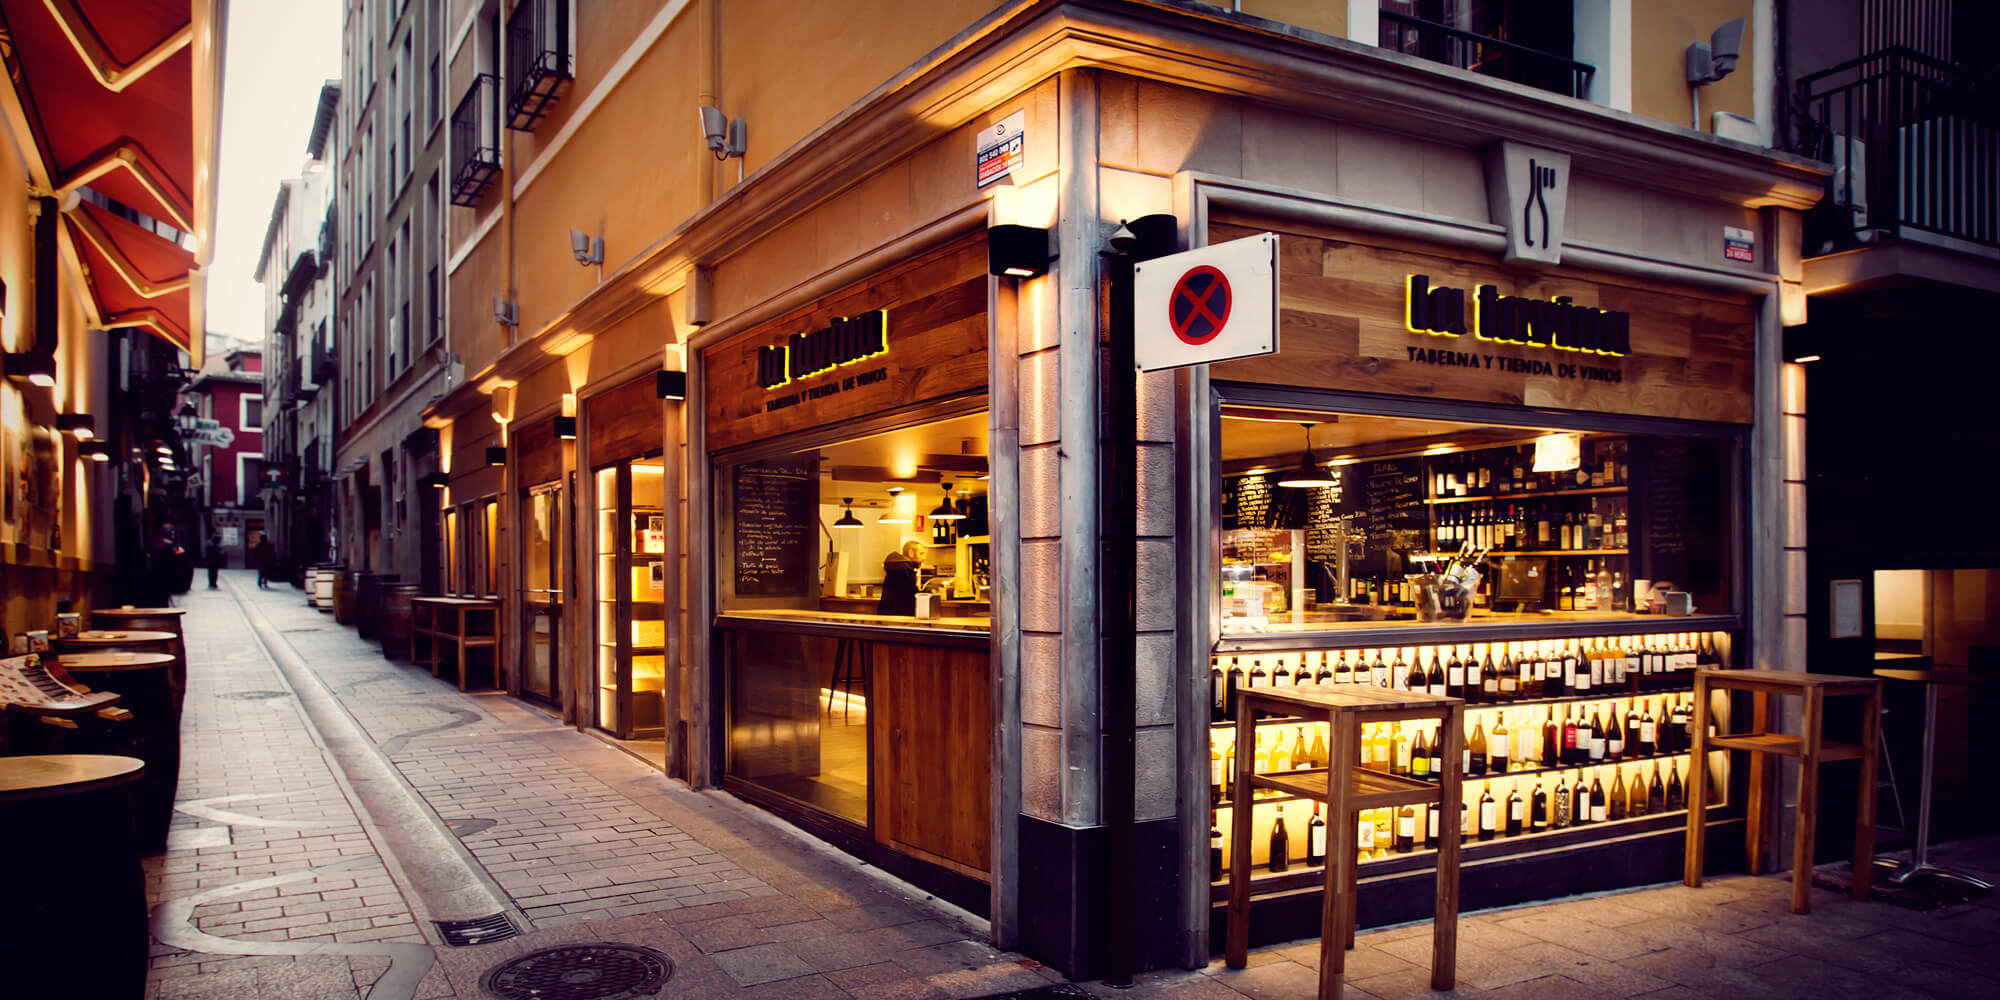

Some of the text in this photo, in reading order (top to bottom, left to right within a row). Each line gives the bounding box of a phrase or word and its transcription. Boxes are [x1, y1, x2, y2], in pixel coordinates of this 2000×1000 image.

[1406, 274, 1632, 357] la tavina
[758, 309, 889, 390] la tavina
[1407, 346, 1623, 383] TABERNA Y TIENDA DE VINOS
[766, 367, 888, 412] TABERNA Y TIENDA DE VINOS
